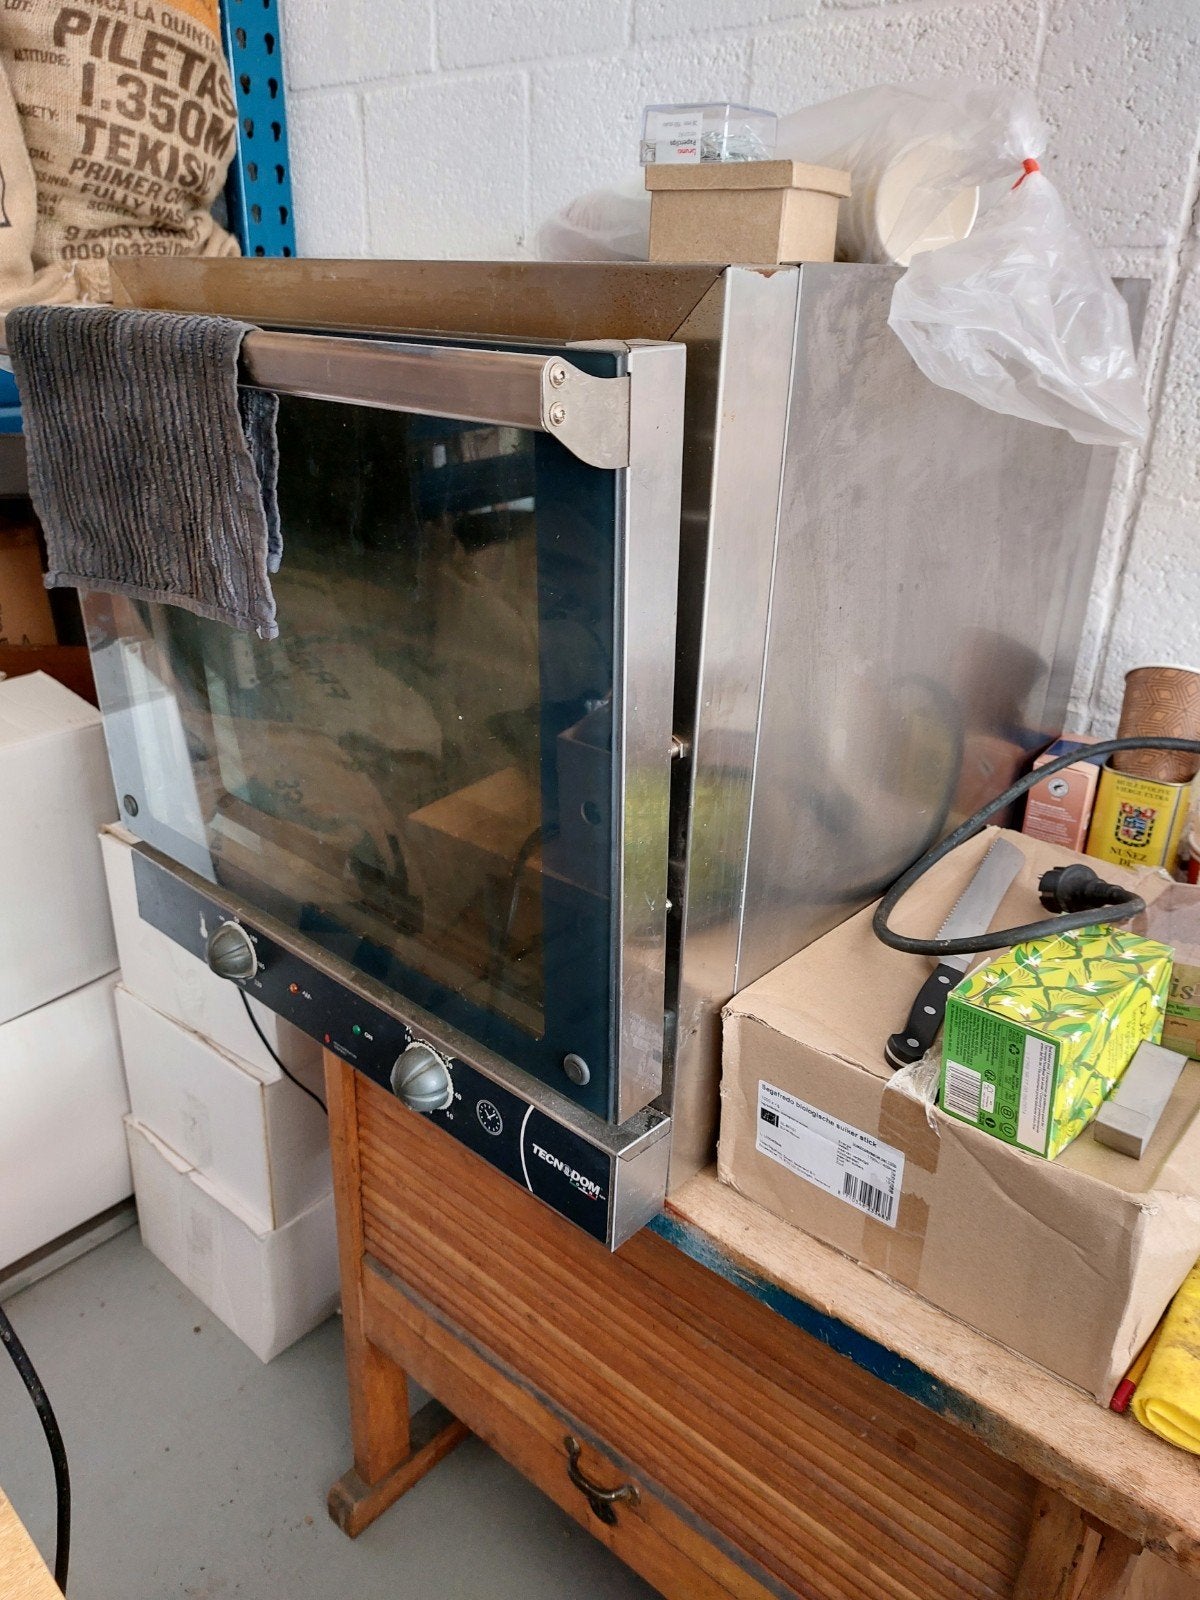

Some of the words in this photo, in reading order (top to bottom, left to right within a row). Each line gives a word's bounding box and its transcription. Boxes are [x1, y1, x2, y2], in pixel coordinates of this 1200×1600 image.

[133, 0, 155, 24] LA
[53, 7, 238, 118] PILETAS
[69, 157, 162, 201] PRIMER
[80, 182, 146, 210] FULLY
[150, 203, 184, 225] WAS
[64, 225, 80, 241] 9
[1170, 978, 1194, 999] is
[761, 1083, 795, 1105] Segafredo
[795, 1101, 835, 1126] biologische
[836, 1124, 858, 1138] suiker
[859, 1133, 877, 1148] stick
